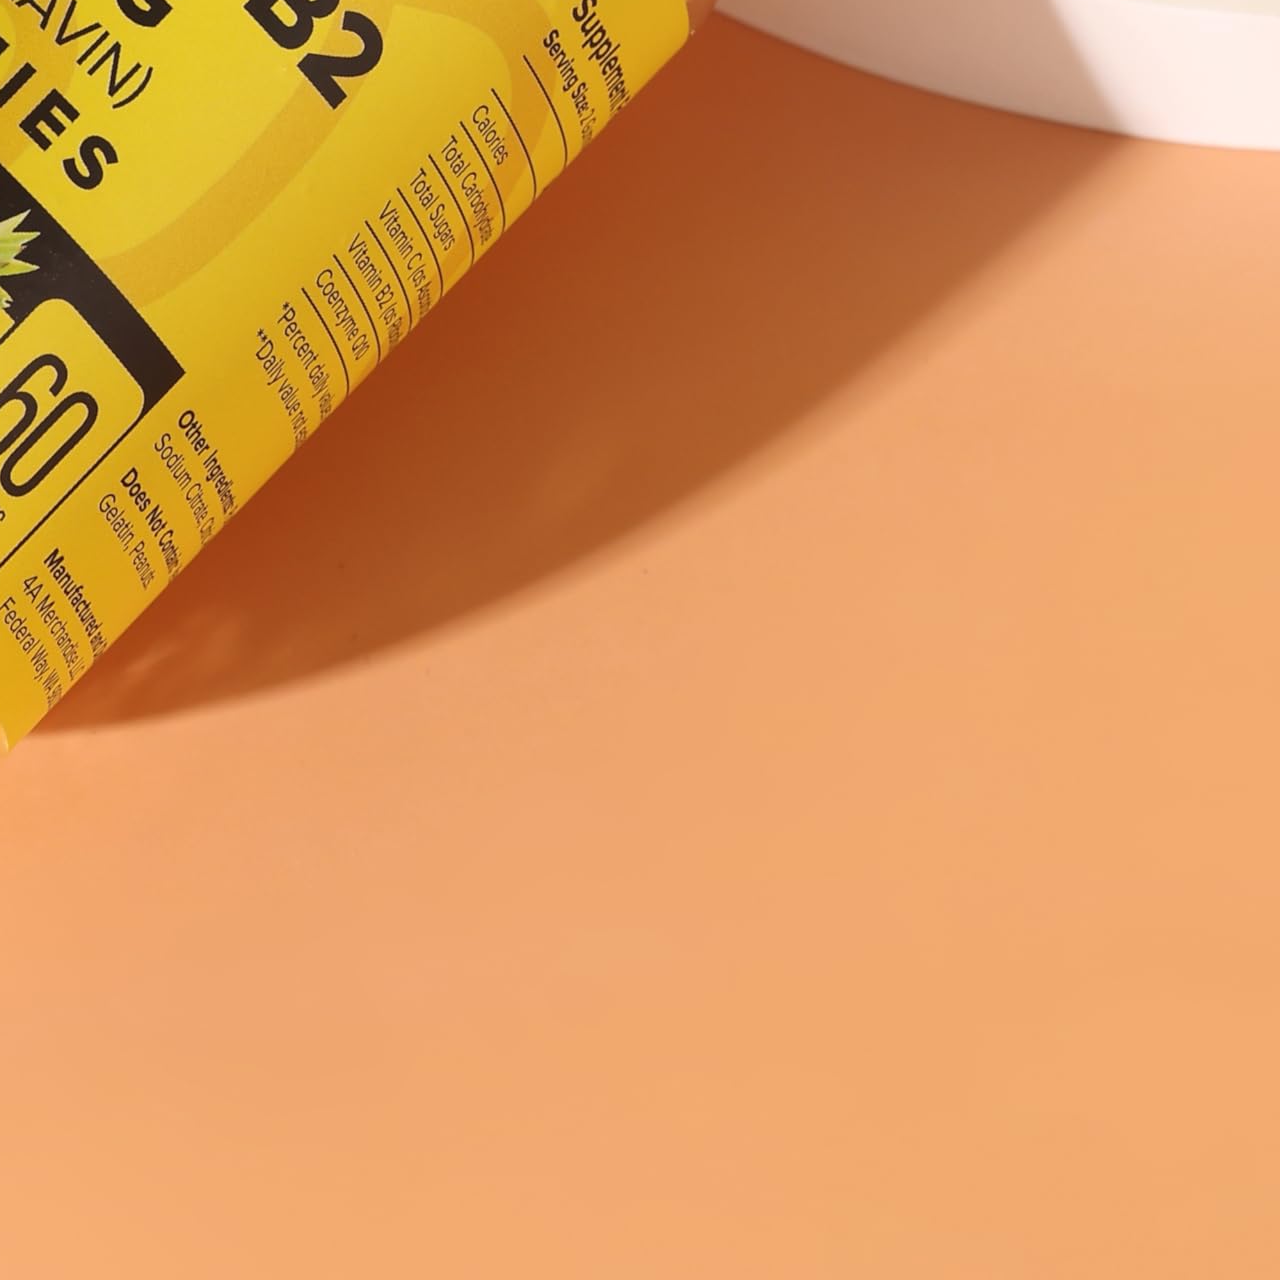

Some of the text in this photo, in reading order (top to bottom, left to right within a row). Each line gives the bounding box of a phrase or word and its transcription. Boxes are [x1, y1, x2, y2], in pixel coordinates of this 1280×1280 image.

[543, 28, 579, 92] Serving
[440, 134, 471, 178] Total
[472, 104, 508, 166] Calories
[379, 200, 414, 261] Vitamin
[406, 252, 422, 271] C
[409, 167, 456, 252] Total Sugars
[315, 269, 360, 341] Coenzyme
[348, 233, 382, 292] Vitamin
[375, 284, 395, 310] B2
[278, 379, 301, 416] value
[153, 432, 193, 490] Sodium
[178, 409, 210, 457] Other
[98, 493, 135, 552] Gelatin,
[120, 467, 151, 513] Does
[145, 504, 168, 537] Not
[23, 575, 44, 603] 4A
[35, 593, 80, 668] Merchandise
[43, 547, 103, 638] Manufactured
